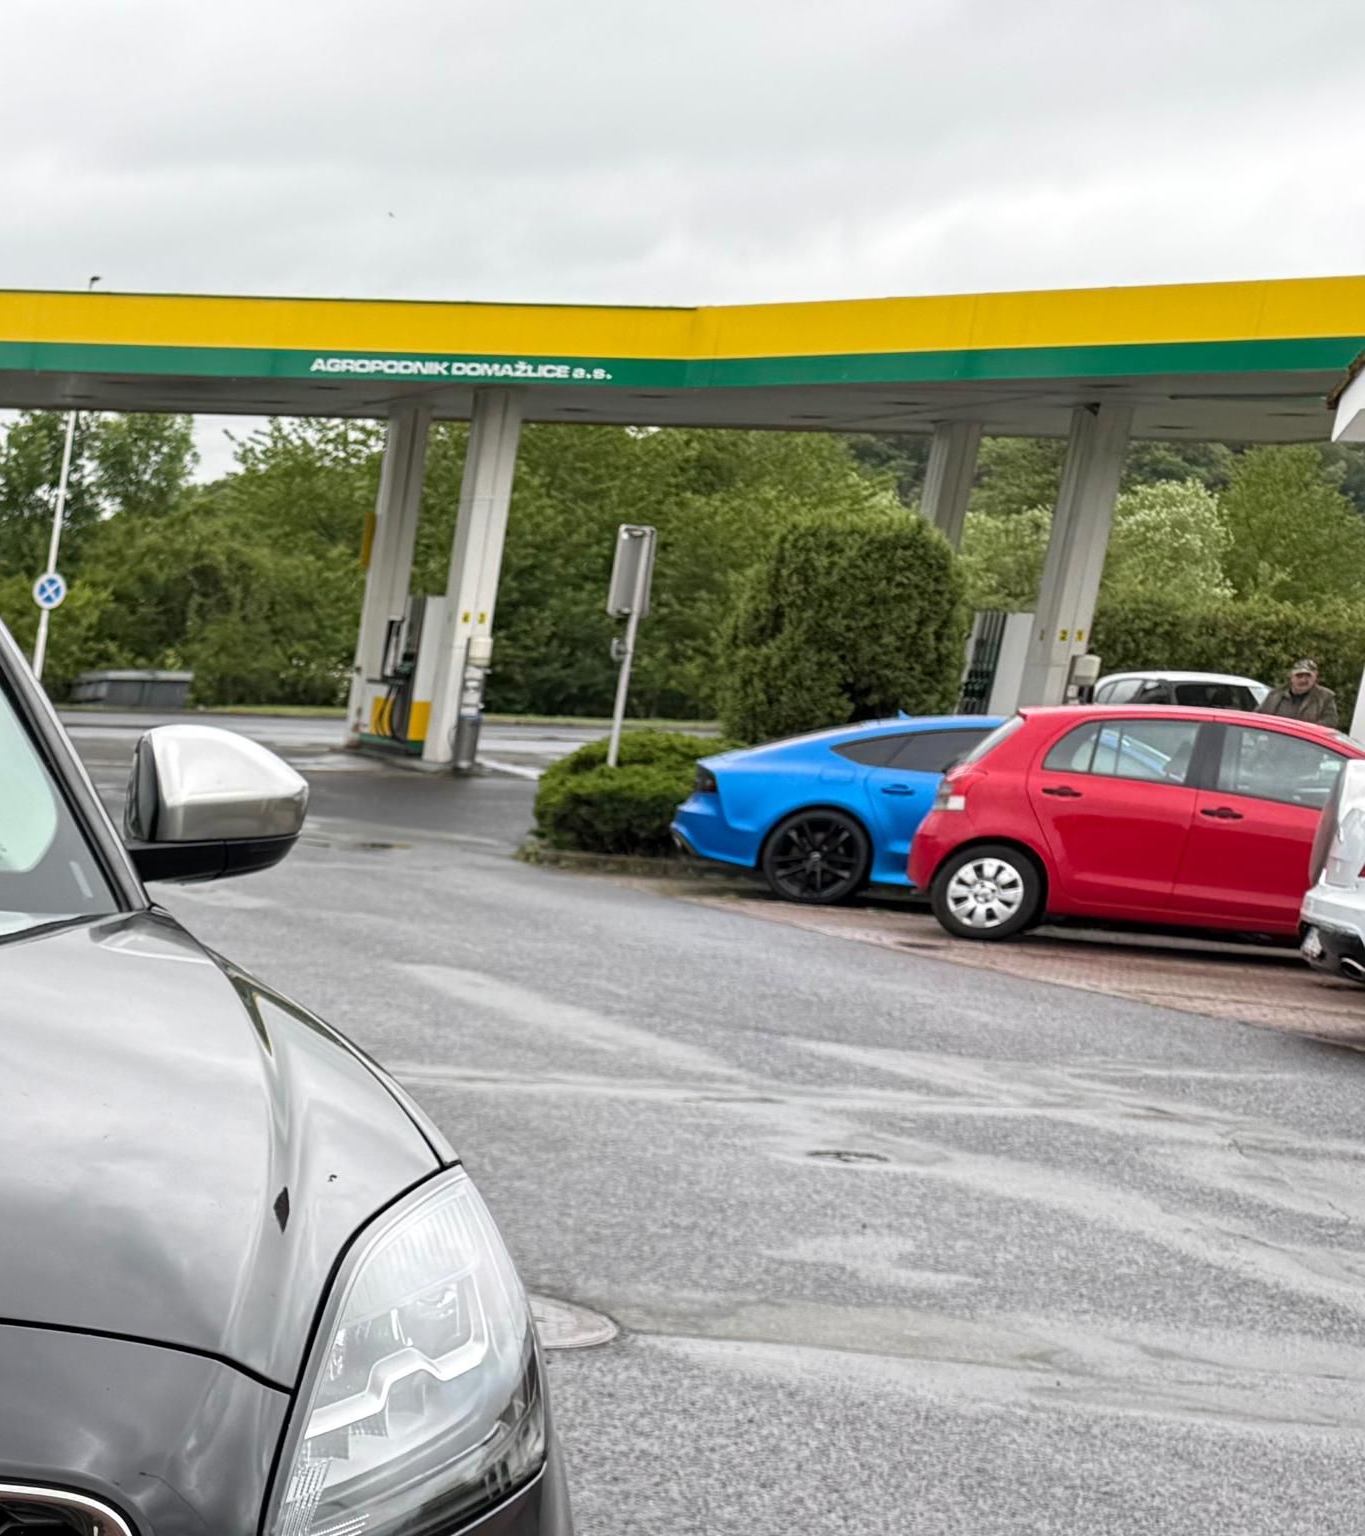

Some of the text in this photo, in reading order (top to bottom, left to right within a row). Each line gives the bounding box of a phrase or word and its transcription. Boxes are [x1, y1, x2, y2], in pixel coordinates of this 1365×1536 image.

[309, 357, 613, 380] AGROPODNIK DOMAŽLICE a.s.
